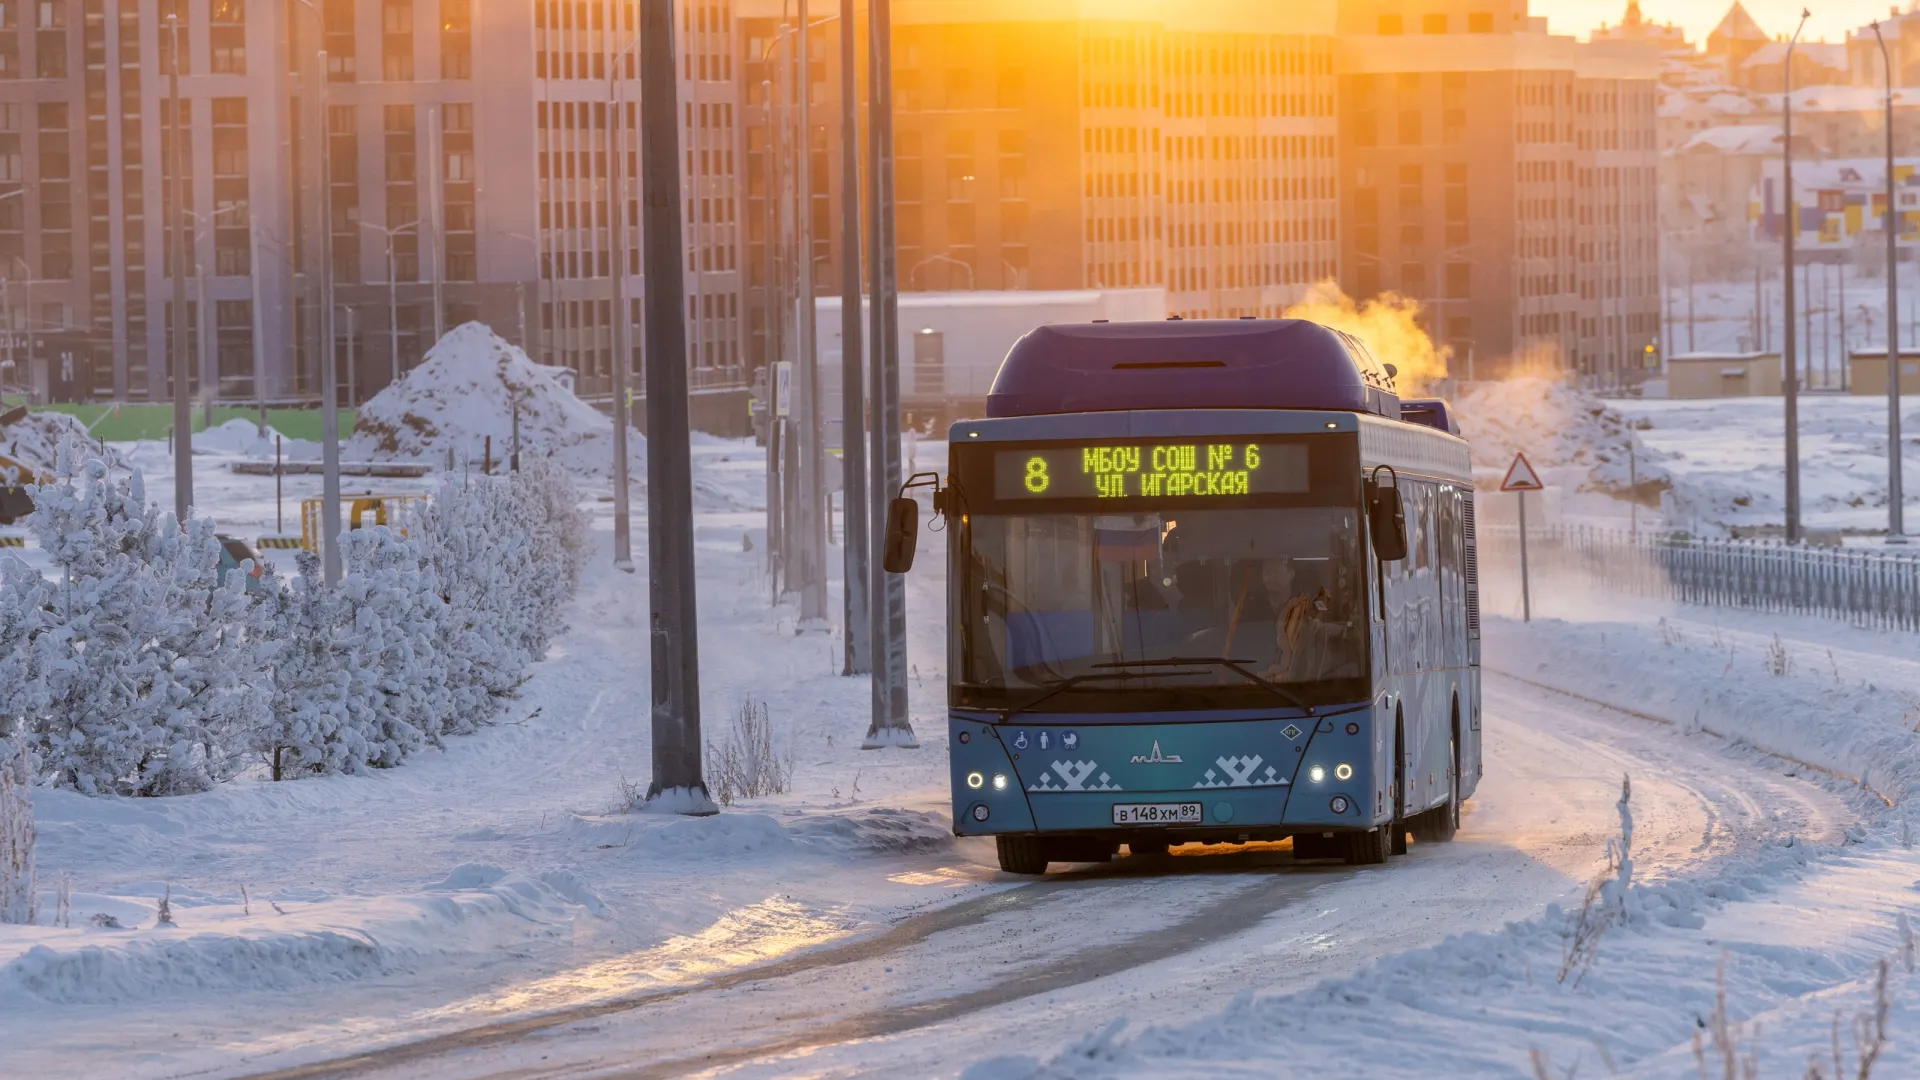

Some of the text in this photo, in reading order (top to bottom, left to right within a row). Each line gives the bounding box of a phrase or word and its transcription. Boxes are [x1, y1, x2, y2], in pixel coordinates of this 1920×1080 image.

[1083, 444, 1260, 473] МБОУ СОШ № 6
[1025, 458, 1049, 493] 8
[1096, 472, 1249, 497] УЛ. ИГАРСКАЯ
